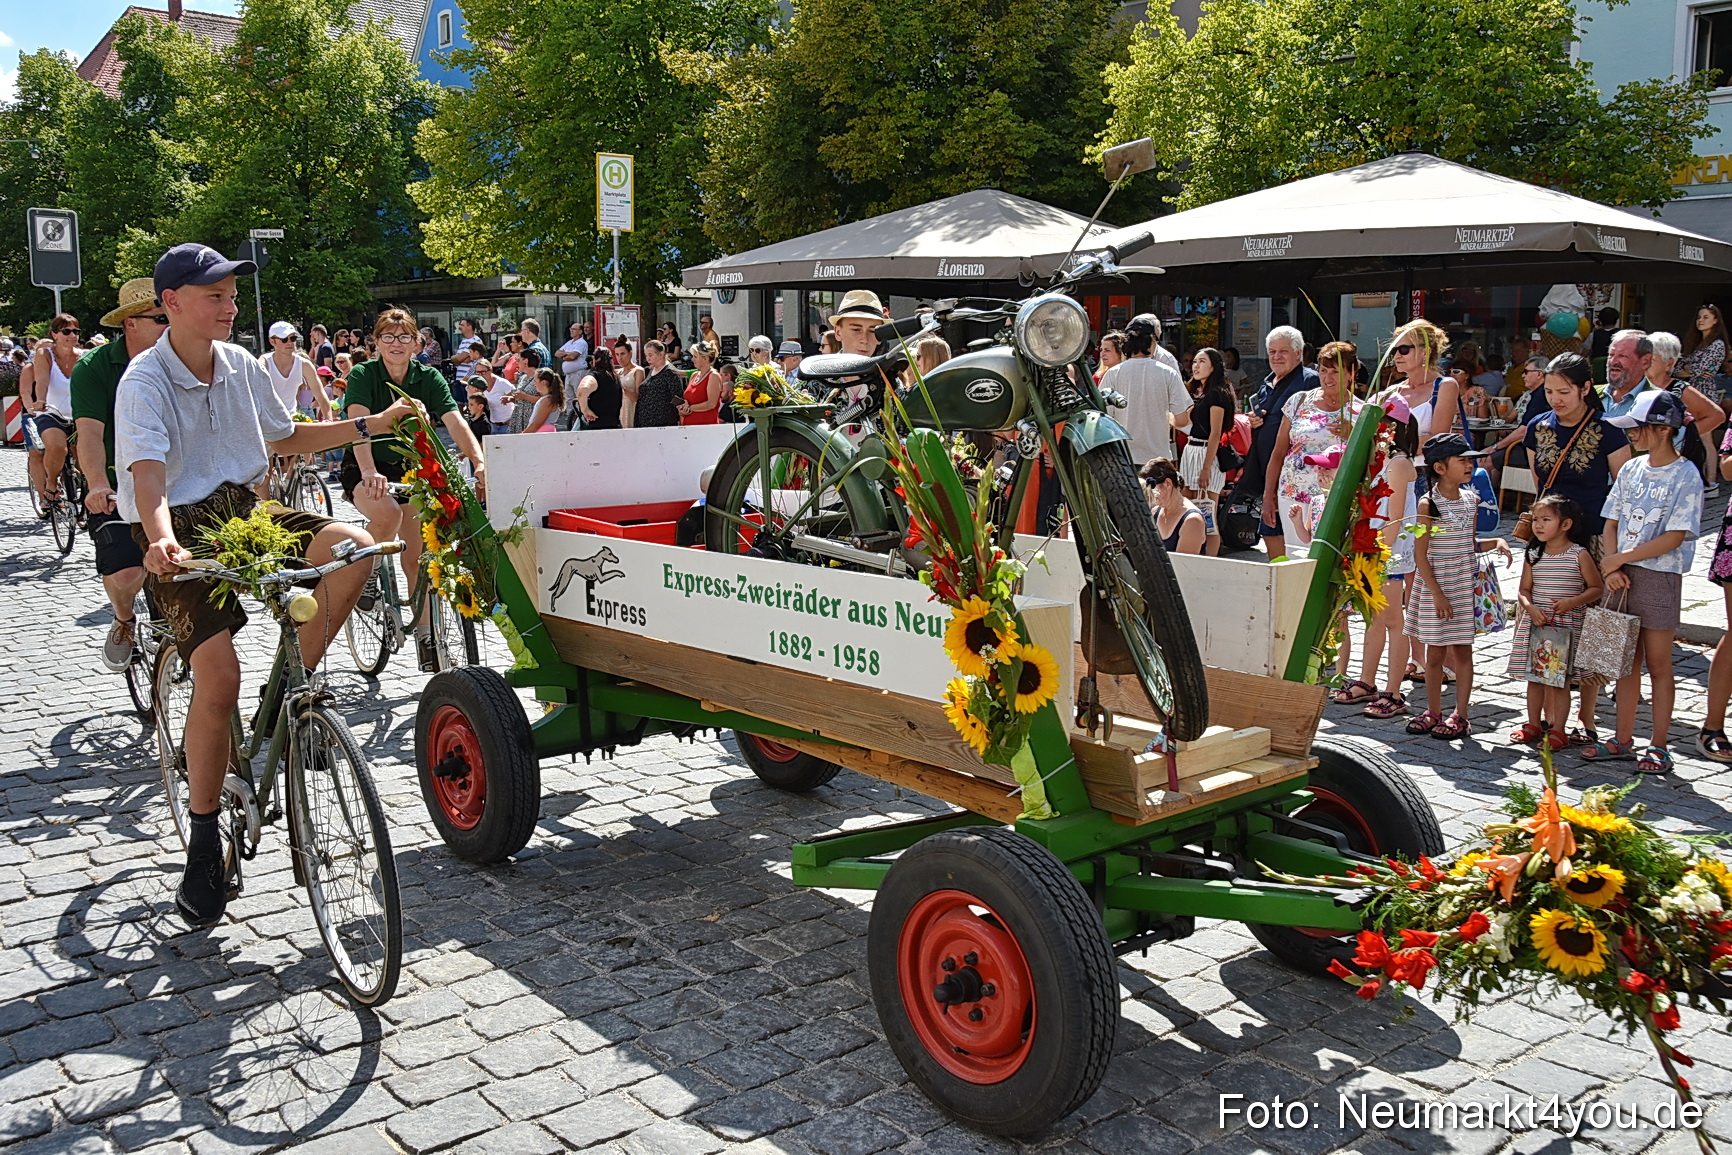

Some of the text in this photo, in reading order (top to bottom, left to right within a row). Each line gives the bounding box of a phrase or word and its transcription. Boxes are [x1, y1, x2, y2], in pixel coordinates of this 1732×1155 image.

[609, 166, 621, 182] H
[1242, 235, 1293, 250] NEUMARKTER
[1454, 226, 1515, 243] NEUMARKTER
[711, 272, 743, 284] LORENZO
[818, 265, 855, 277] LORENZO
[944, 264, 984, 276] LORENZO
[586, 580, 647, 626] Express
[663, 563, 950, 639] Express-Zweiräder aus Neu
[769, 630, 812, 661] 1882
[834, 643, 880, 675] 1958
